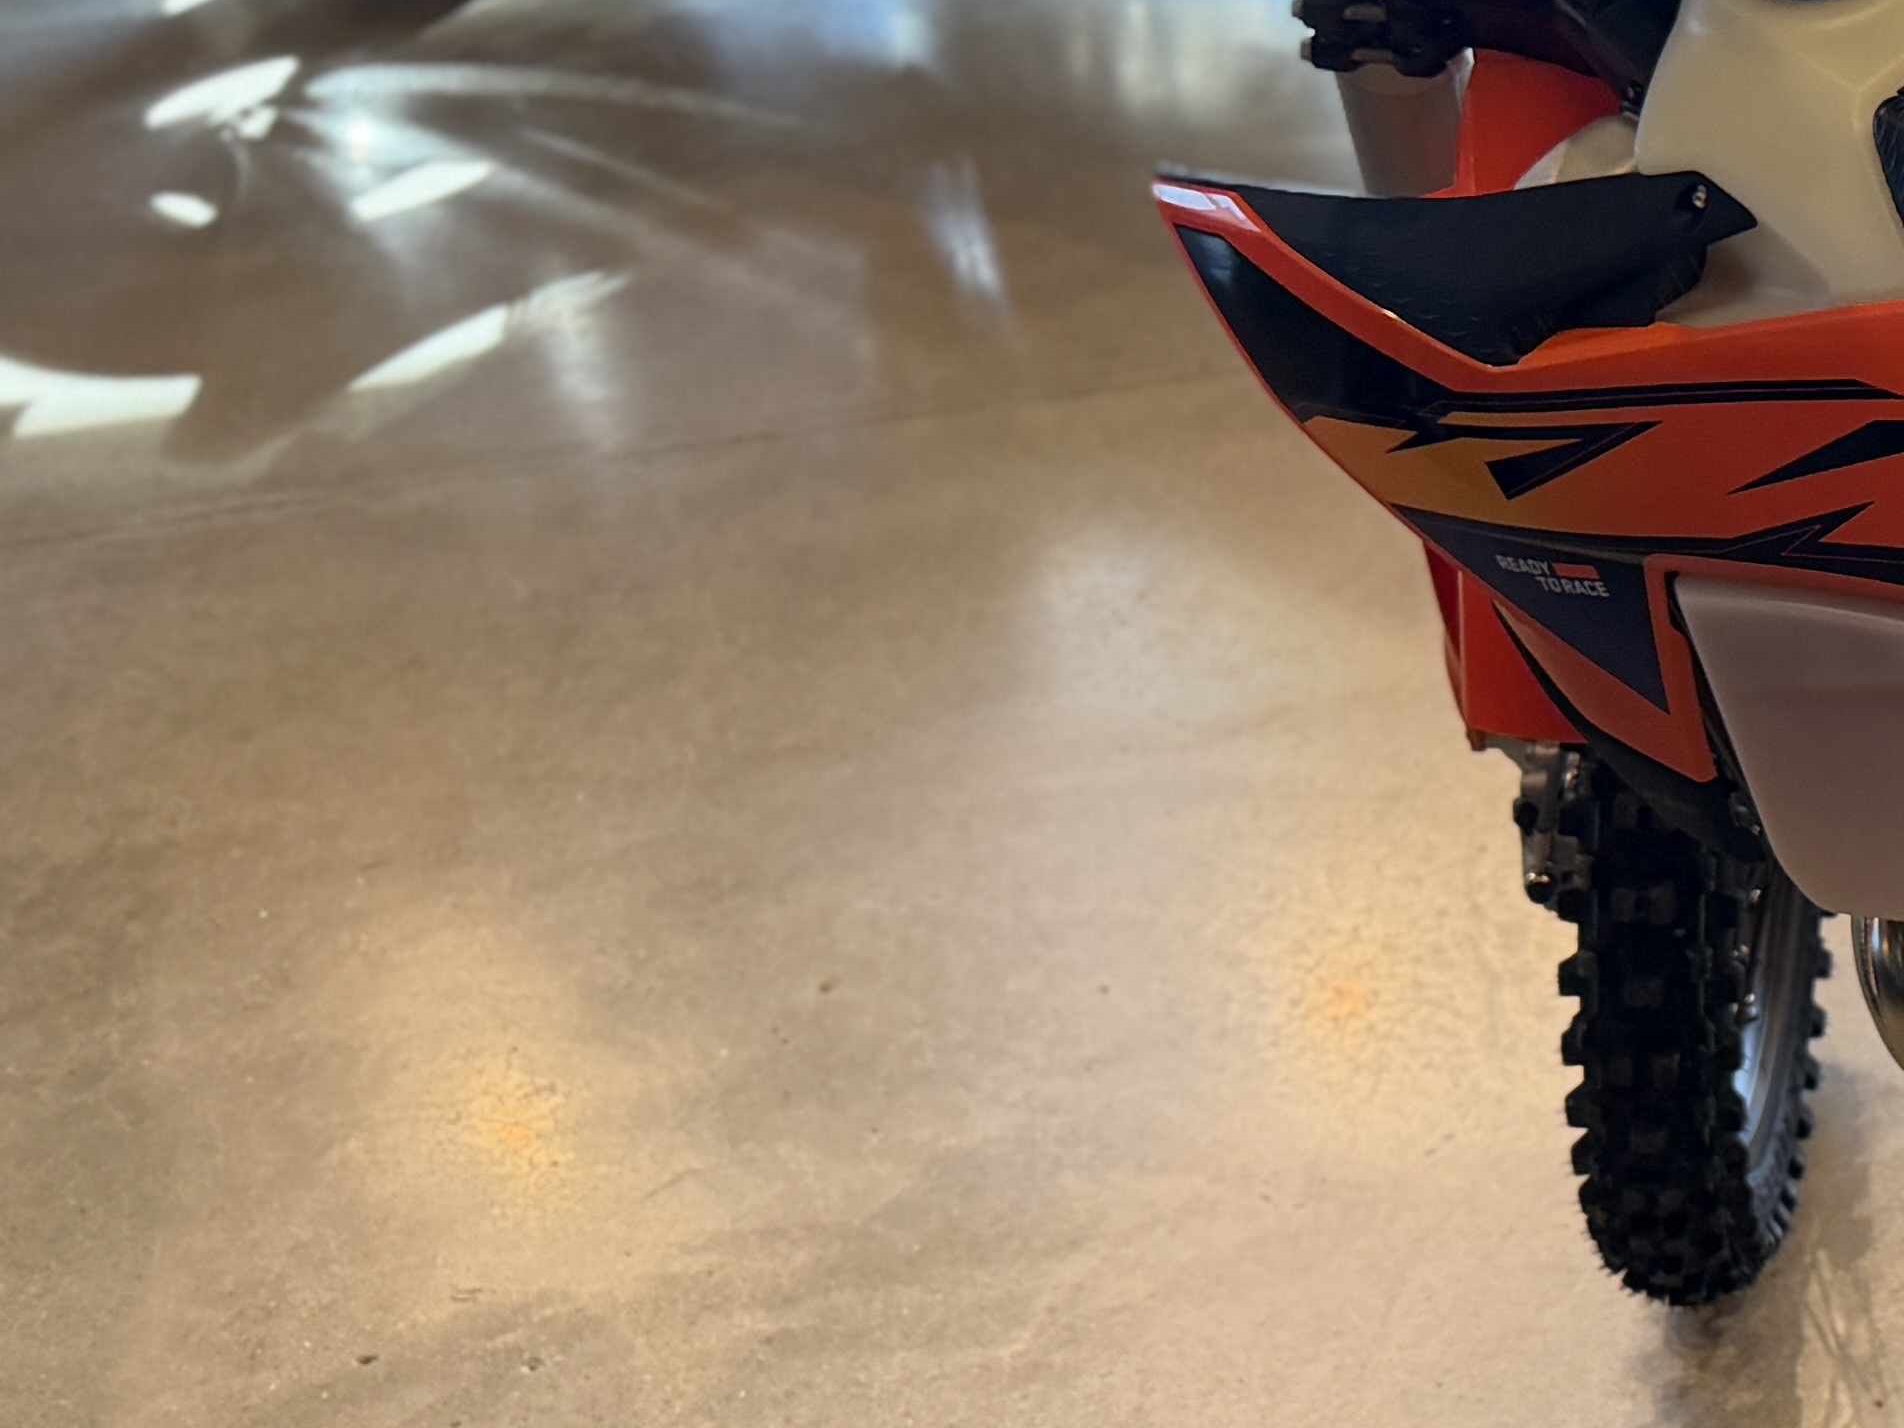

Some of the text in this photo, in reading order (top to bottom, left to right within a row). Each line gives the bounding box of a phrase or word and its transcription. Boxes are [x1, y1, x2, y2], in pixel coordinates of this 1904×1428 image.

[1496, 554, 1550, 575] READY
[1535, 576, 1610, 598] TO RACE
